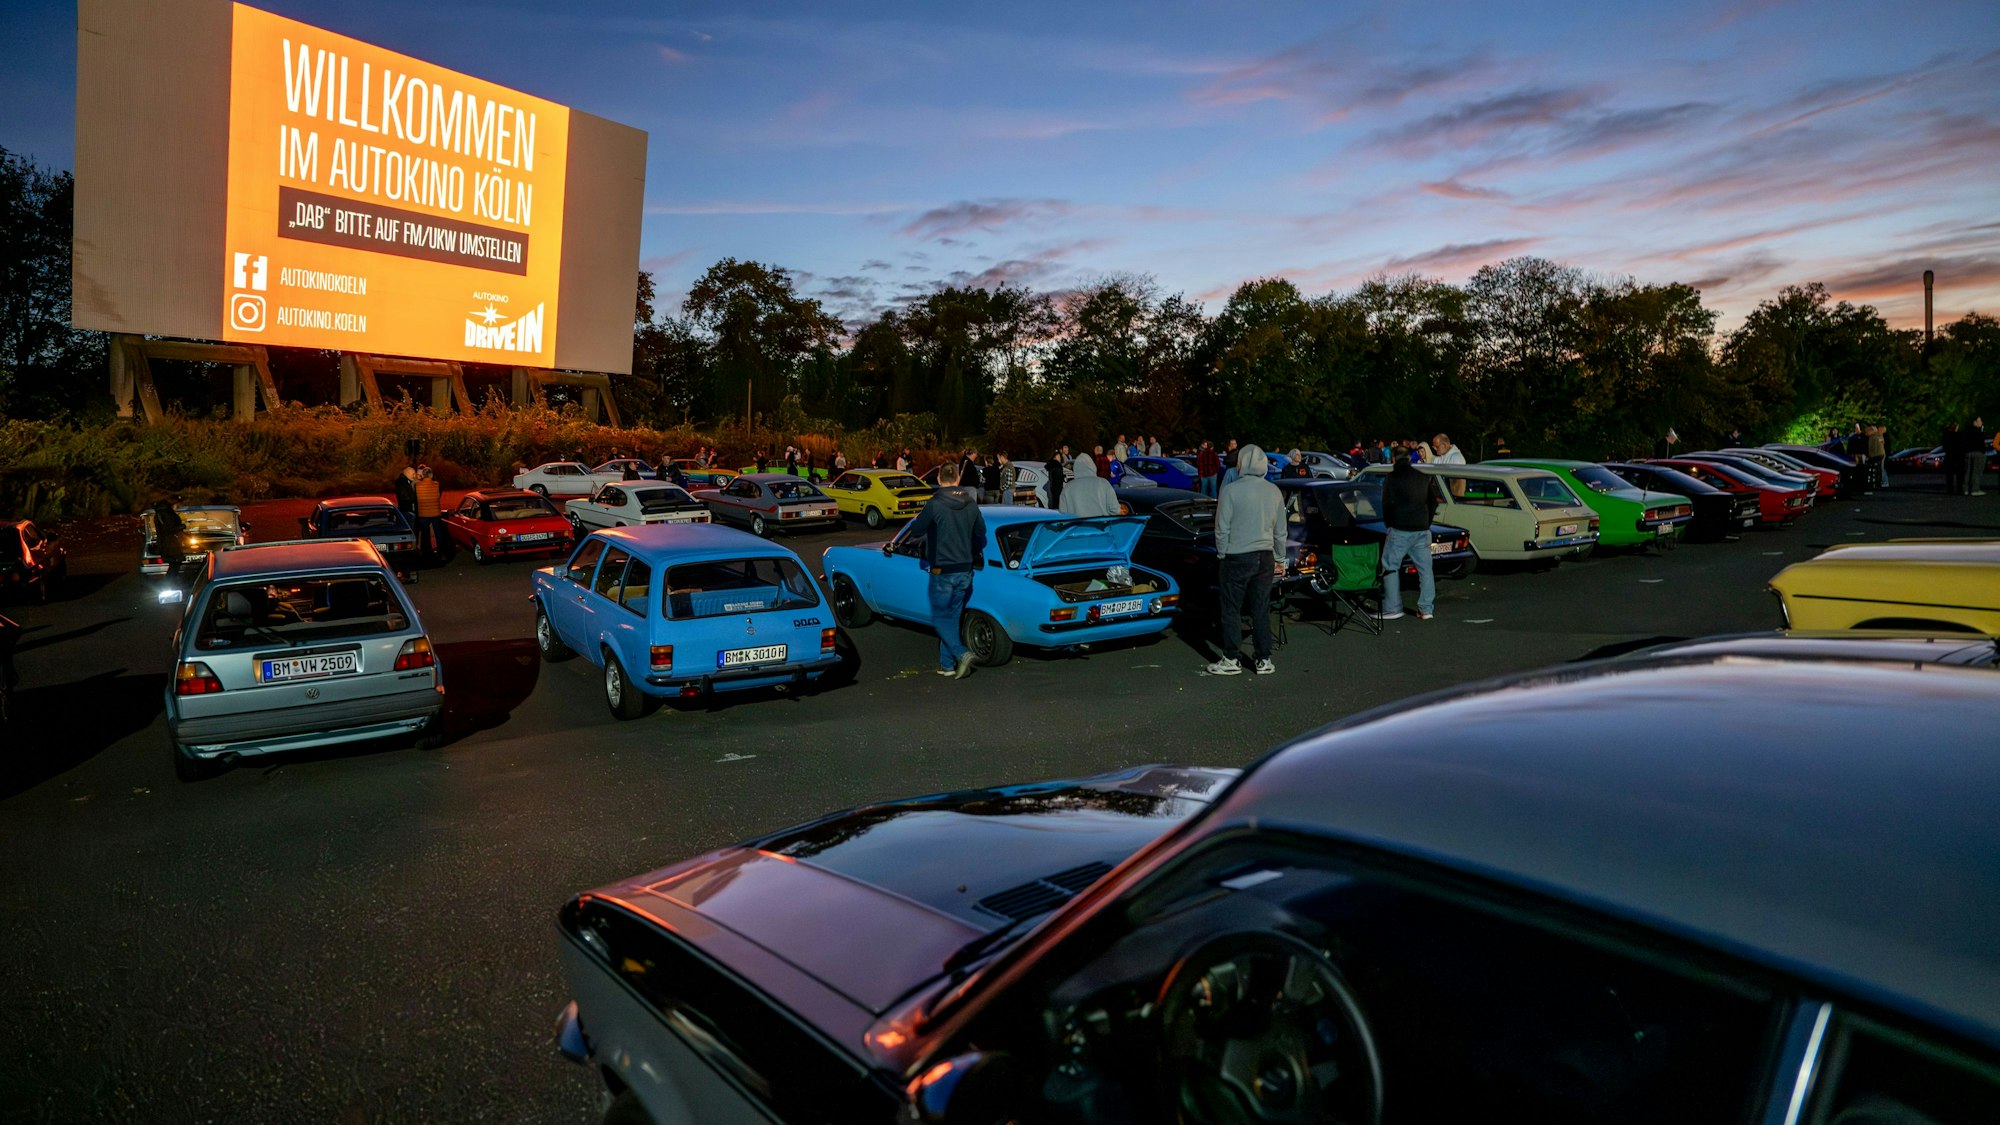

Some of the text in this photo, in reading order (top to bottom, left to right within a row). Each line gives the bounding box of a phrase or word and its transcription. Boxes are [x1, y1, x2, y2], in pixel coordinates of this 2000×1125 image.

[282, 38, 536, 172] WILLKOMMEN
[279, 124, 533, 227] IM AUTOKINO KÖLN
[335, 209, 372, 239] BITTE
[374, 216, 401, 242] AUF
[403, 221, 457, 252] FM/UKW
[459, 231, 522, 264] UMSTELLEN
[280, 266, 367, 296] AUTOKINOKOELN
[472, 291, 509, 304] AUTOKINO
[277, 306, 367, 333] AUTOKINO.KOELN
[465, 318, 516, 351] DRIVE
[1101, 604, 1113, 615] BM
[273, 656, 352, 676] BM VW 2509
[725, 646, 785, 664] BM K 3010 H
